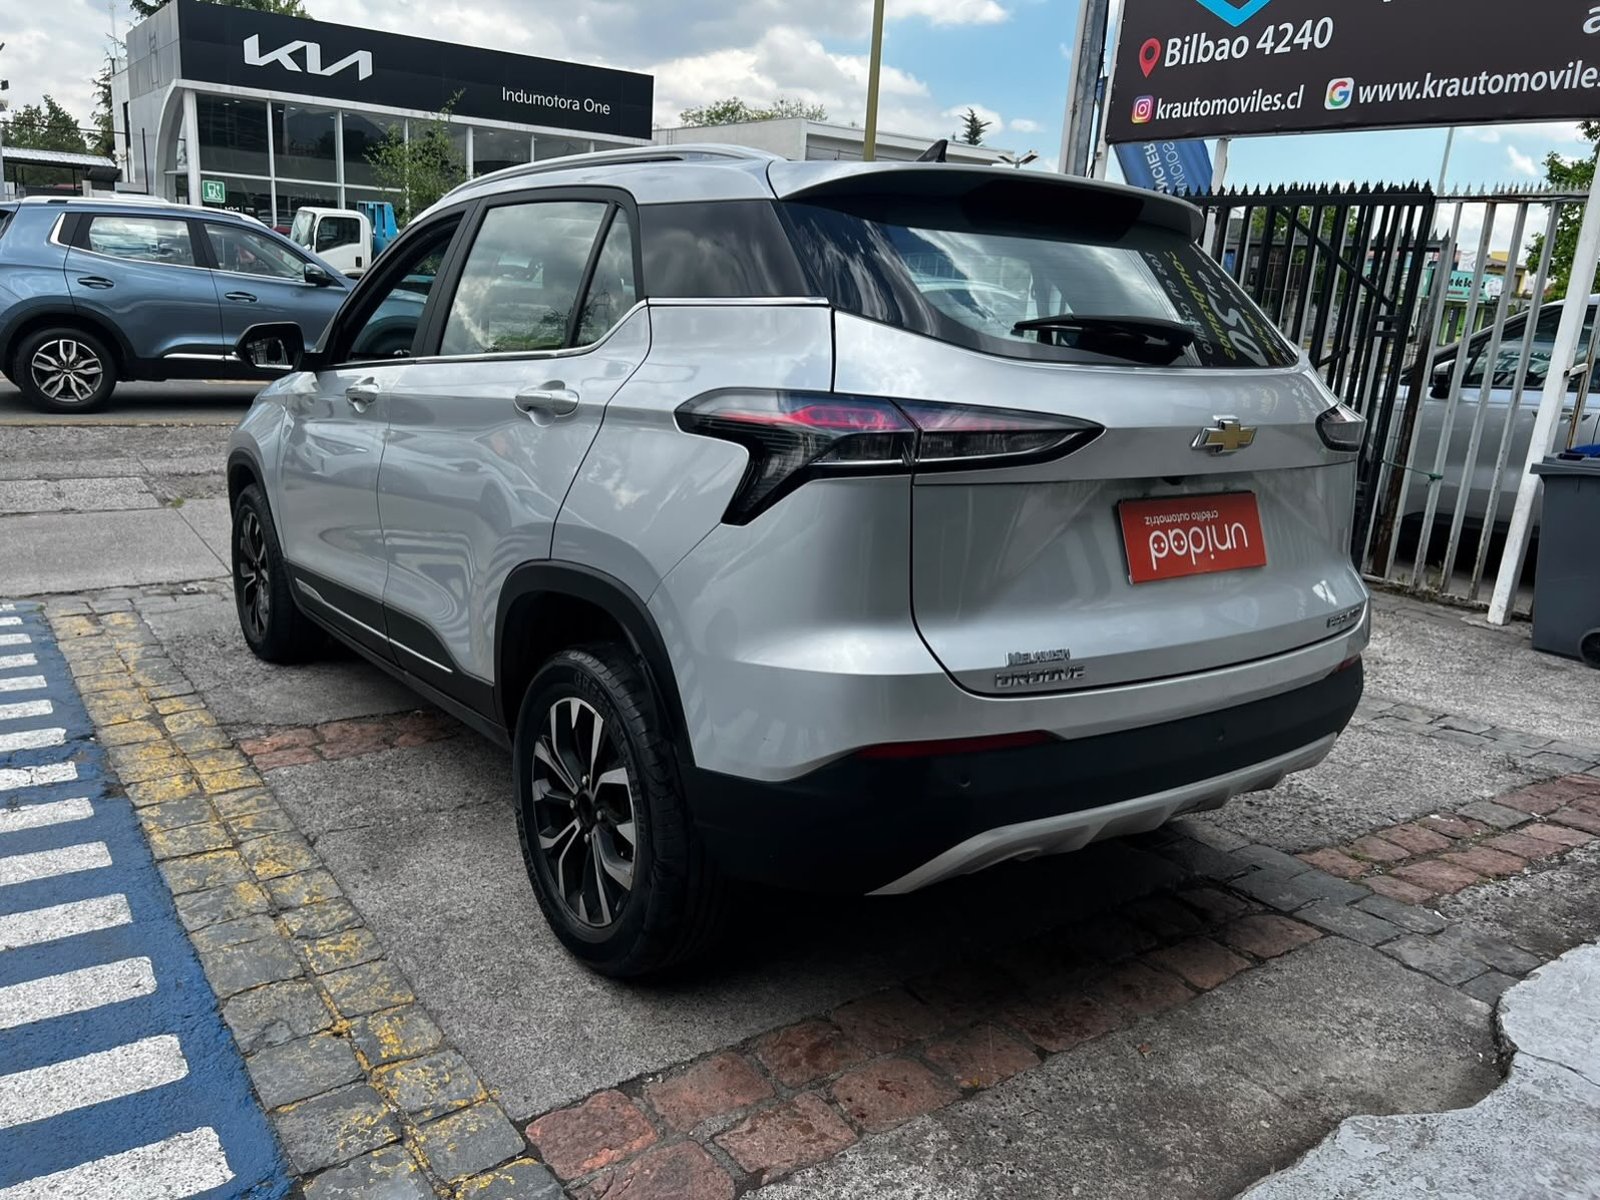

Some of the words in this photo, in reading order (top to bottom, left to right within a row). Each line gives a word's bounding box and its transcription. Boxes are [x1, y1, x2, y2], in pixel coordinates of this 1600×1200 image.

[243, 33, 373, 81] KIA
[1164, 32, 1250, 67] Bilbao
[1256, 16, 1334, 55] 4240
[502, 86, 580, 111] Indumotora
[583, 98, 611, 115] One
[1155, 84, 1305, 120] krautomoviles.cl
[1144, 512, 1190, 526] automotriz
[1149, 522, 1249, 571] unidad
